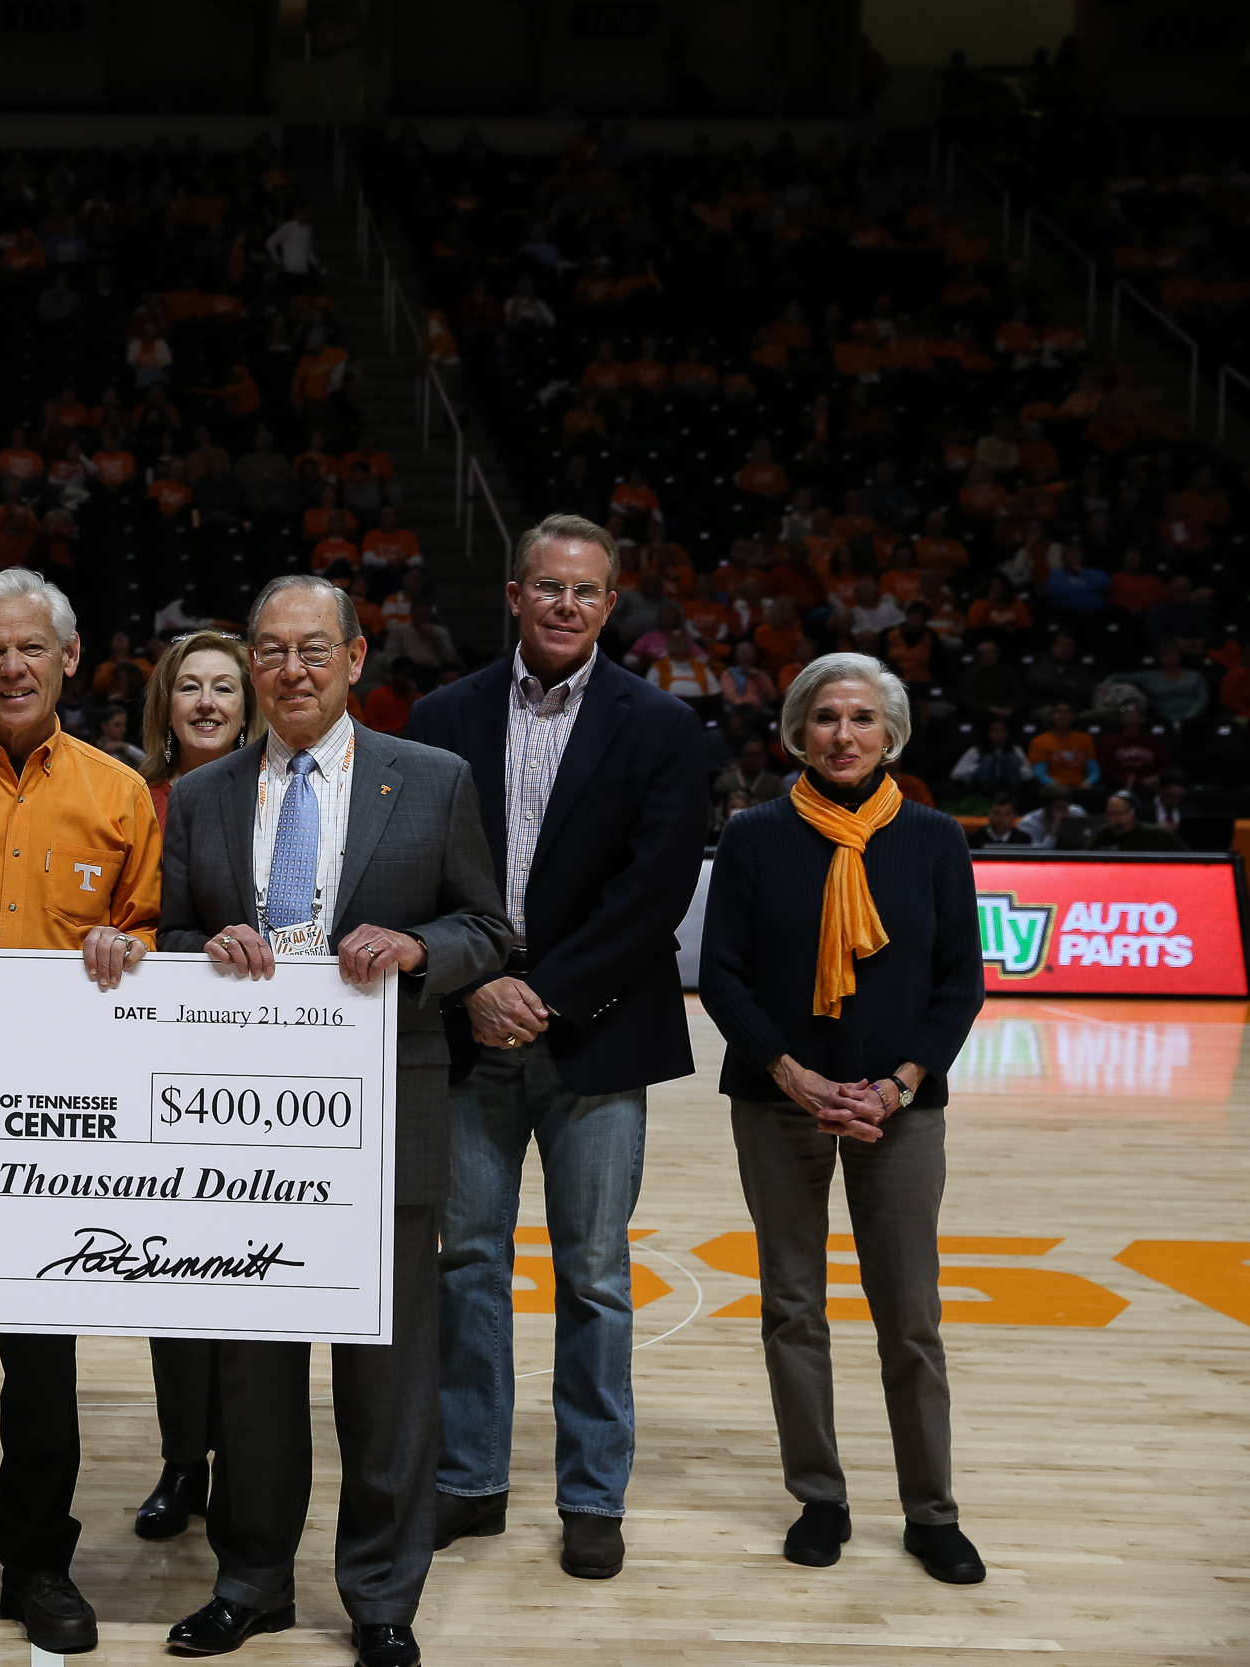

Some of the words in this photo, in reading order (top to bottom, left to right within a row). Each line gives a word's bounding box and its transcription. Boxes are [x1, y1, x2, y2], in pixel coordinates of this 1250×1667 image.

[74, 862, 102, 892] T
[1060, 901, 1178, 934] AUTO
[1058, 934, 1193, 967] PARTS
[114, 1006, 157, 1020] DATE
[176, 1004, 252, 1028] January
[258, 1006, 288, 1027] 21,
[295, 1007, 344, 1026] 2016
[0, 1094, 22, 1108] OF
[27, 1095, 118, 1111] TENNESSEE
[160, 1085, 352, 1134] $400,000
[4, 1111, 118, 1139] CENTER
[191, 1167, 332, 1203] Dollars
